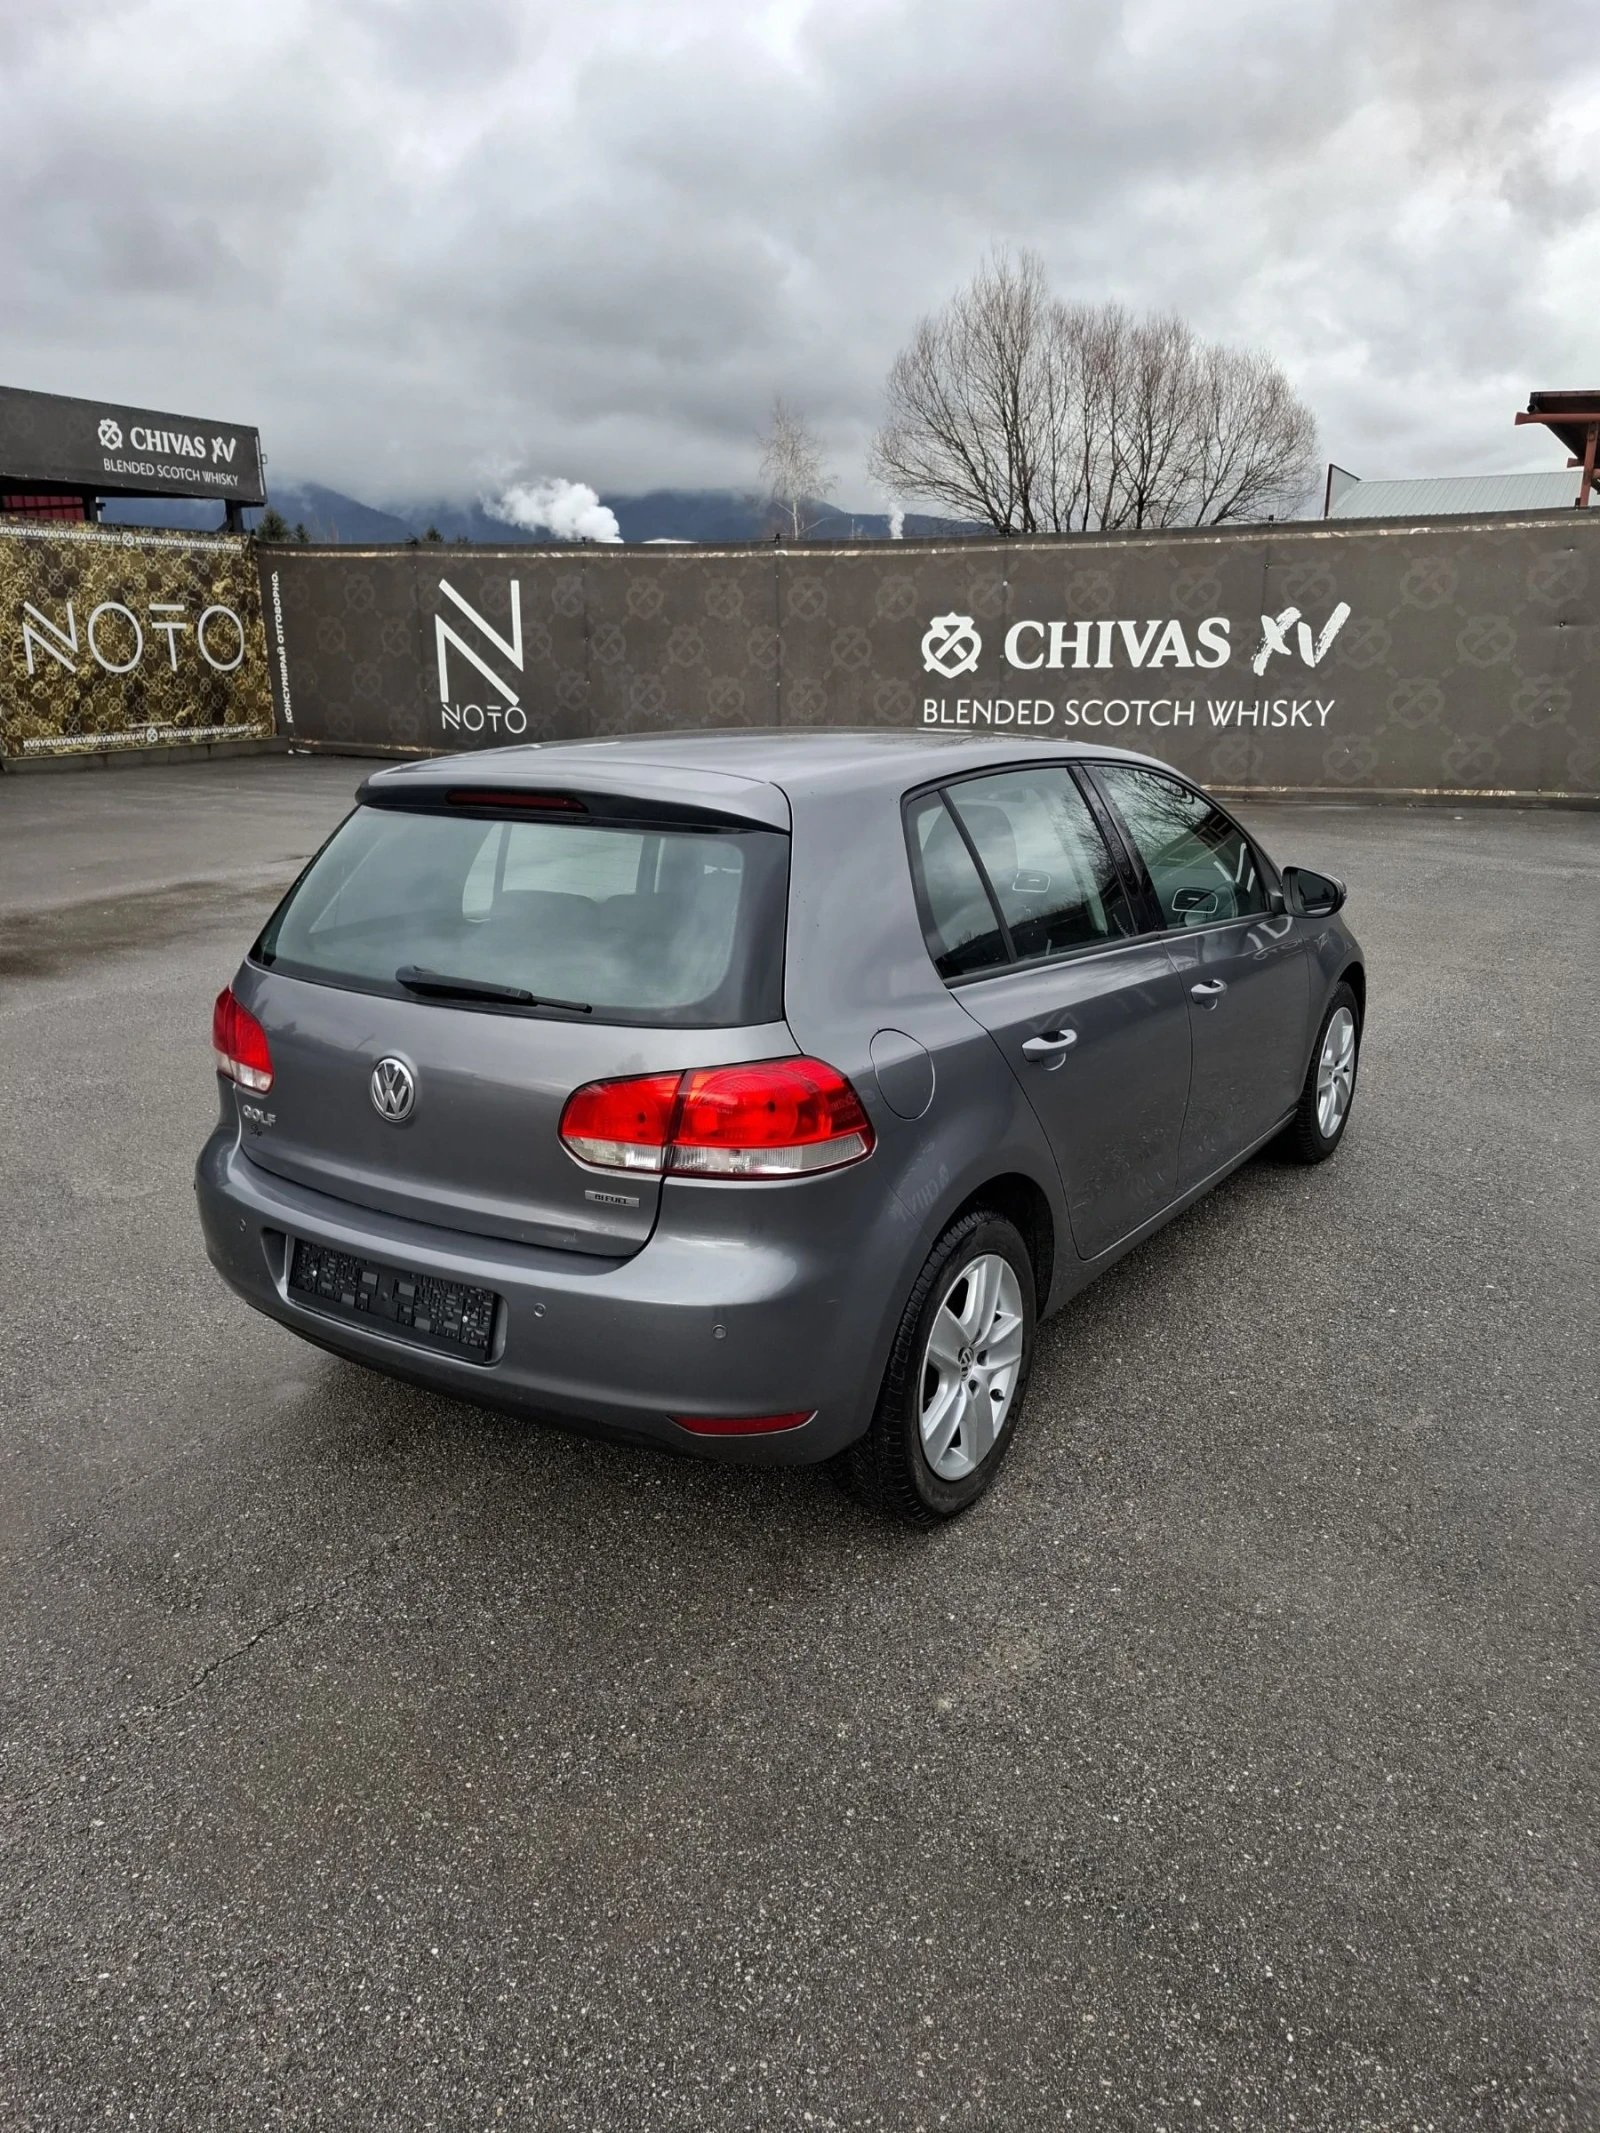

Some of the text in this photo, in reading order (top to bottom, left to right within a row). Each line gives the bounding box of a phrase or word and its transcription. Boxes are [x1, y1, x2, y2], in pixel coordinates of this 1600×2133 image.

[130, 427, 236, 464] CHIVAS XV
[103, 458, 239, 487] BLENDED SCOTCH WHISKY
[22, 601, 244, 674] NOTO
[271, 571, 294, 724] КОНСУМИРАЙ ОТГОВОРНО.
[1004, 602, 1351, 676] CHIVAS XV
[441, 704, 527, 734] NOTO
[923, 699, 1335, 727] BLENDED SCOTCH WHISKY
[242, 1104, 276, 1127] GOLF
